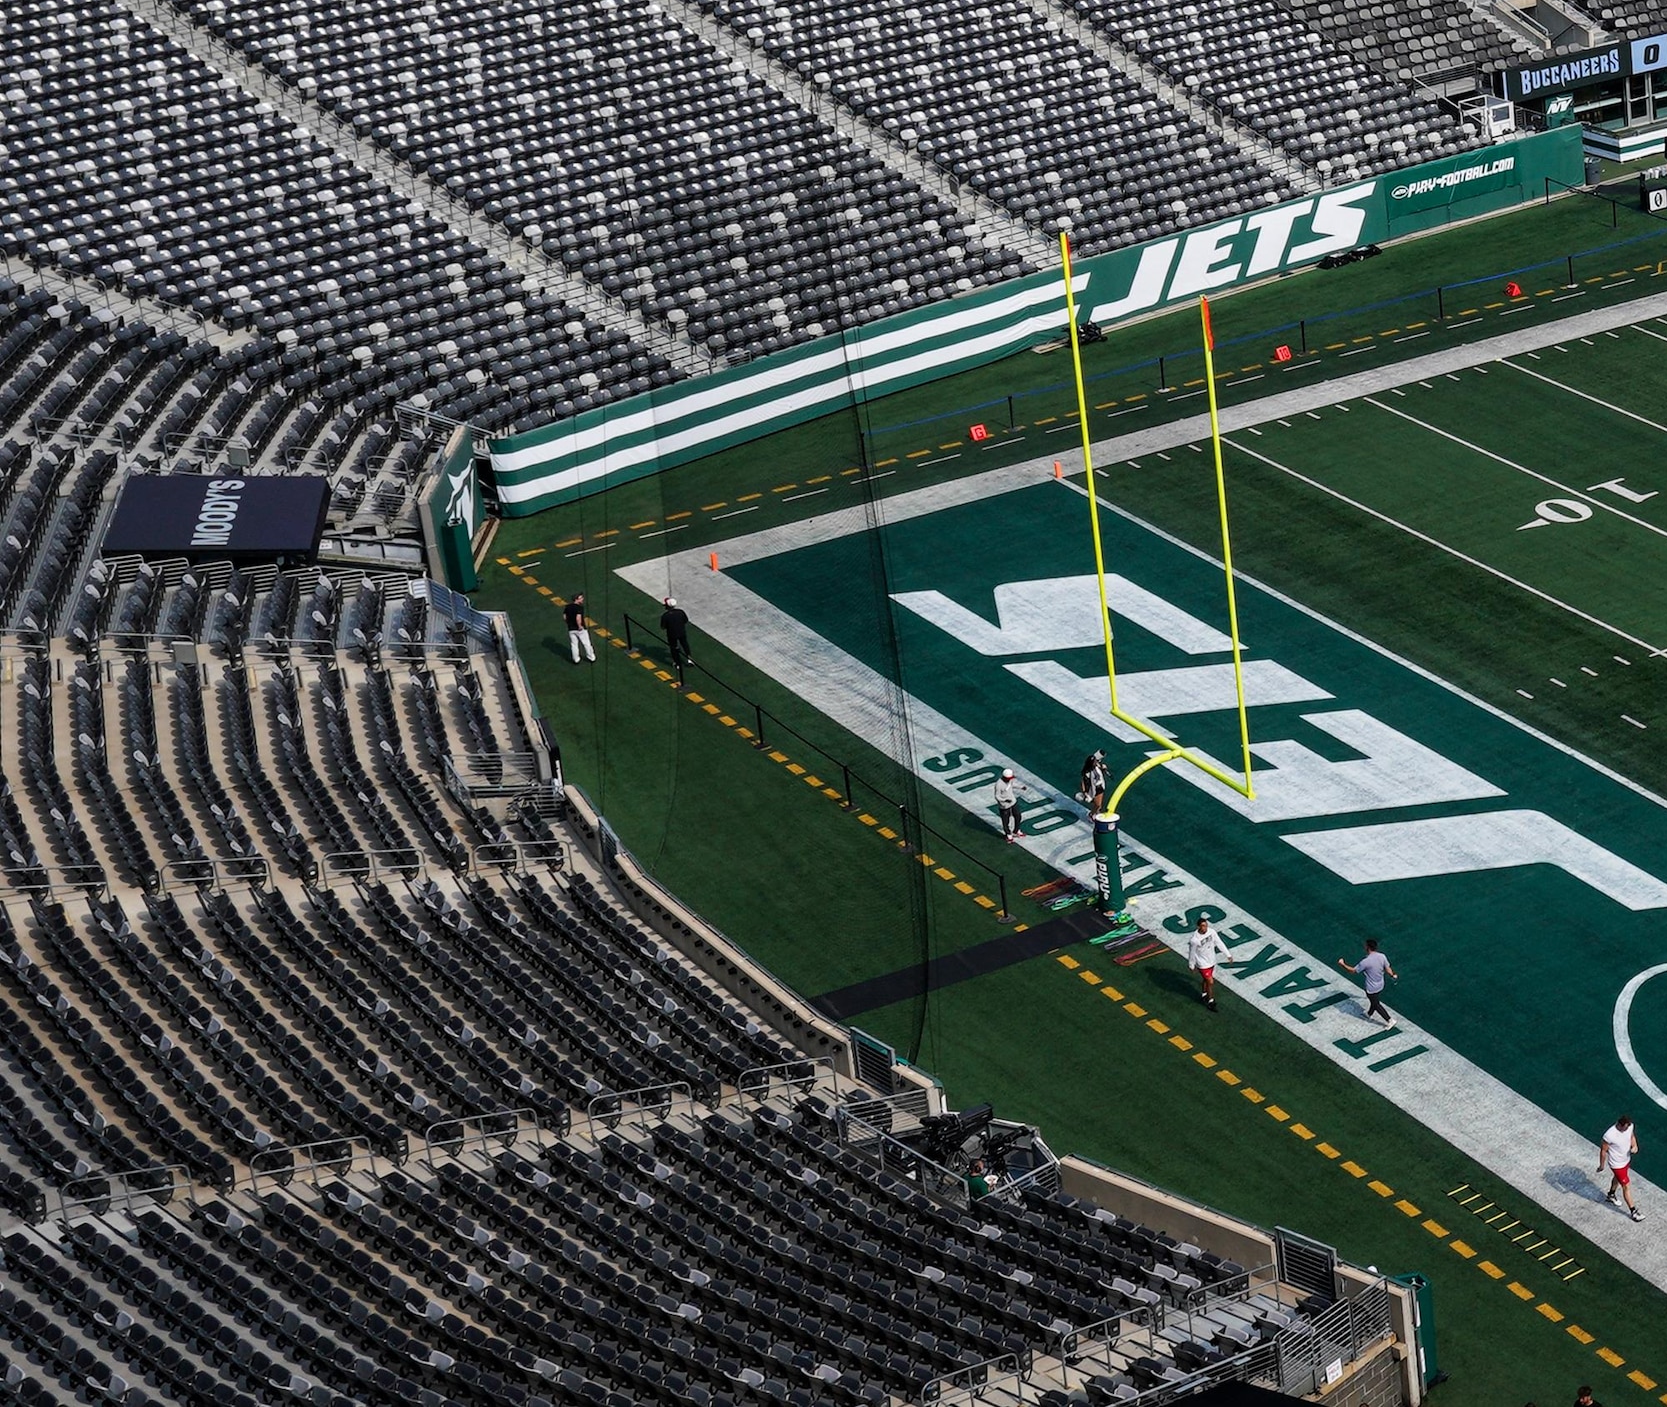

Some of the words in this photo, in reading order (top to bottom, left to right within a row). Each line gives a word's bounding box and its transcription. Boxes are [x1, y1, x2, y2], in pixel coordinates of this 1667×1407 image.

[1520, 49, 1619, 95] BUCCANEERS
[1644, 44, 1660, 65] 0
[1089, 182, 1377, 323] JETS
[190, 480, 246, 545] MOODY'S
[1534, 477, 1658, 523] 10
[1162, 904, 1361, 1023] TAKES
[1332, 1027, 1430, 1074] IT
